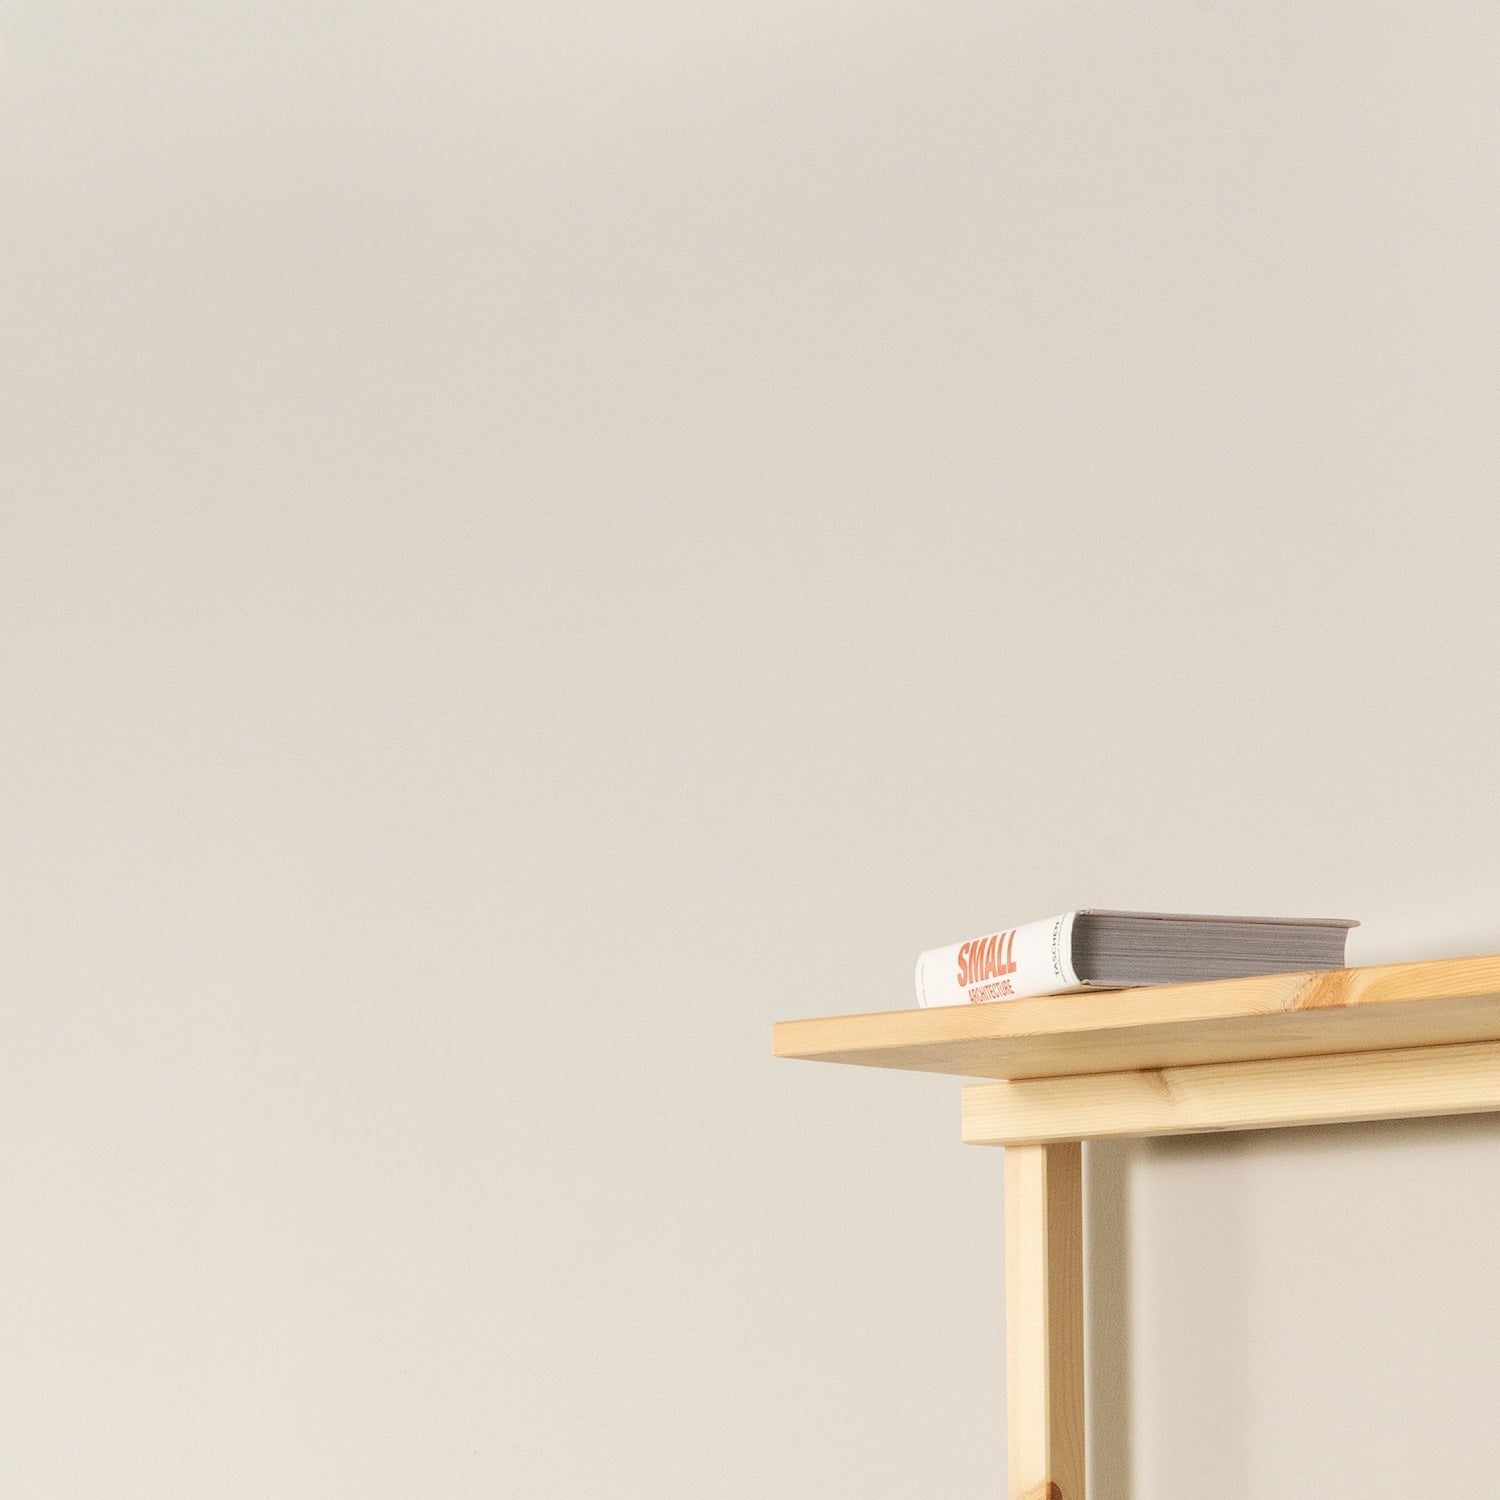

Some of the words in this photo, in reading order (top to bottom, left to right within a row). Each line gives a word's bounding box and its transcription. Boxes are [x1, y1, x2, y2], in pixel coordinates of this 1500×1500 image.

[957, 929, 1017, 987] SMALL
[1051, 921, 1060, 975] TASCHEN
[968, 979, 1015, 1004] ARCHITECTURE
